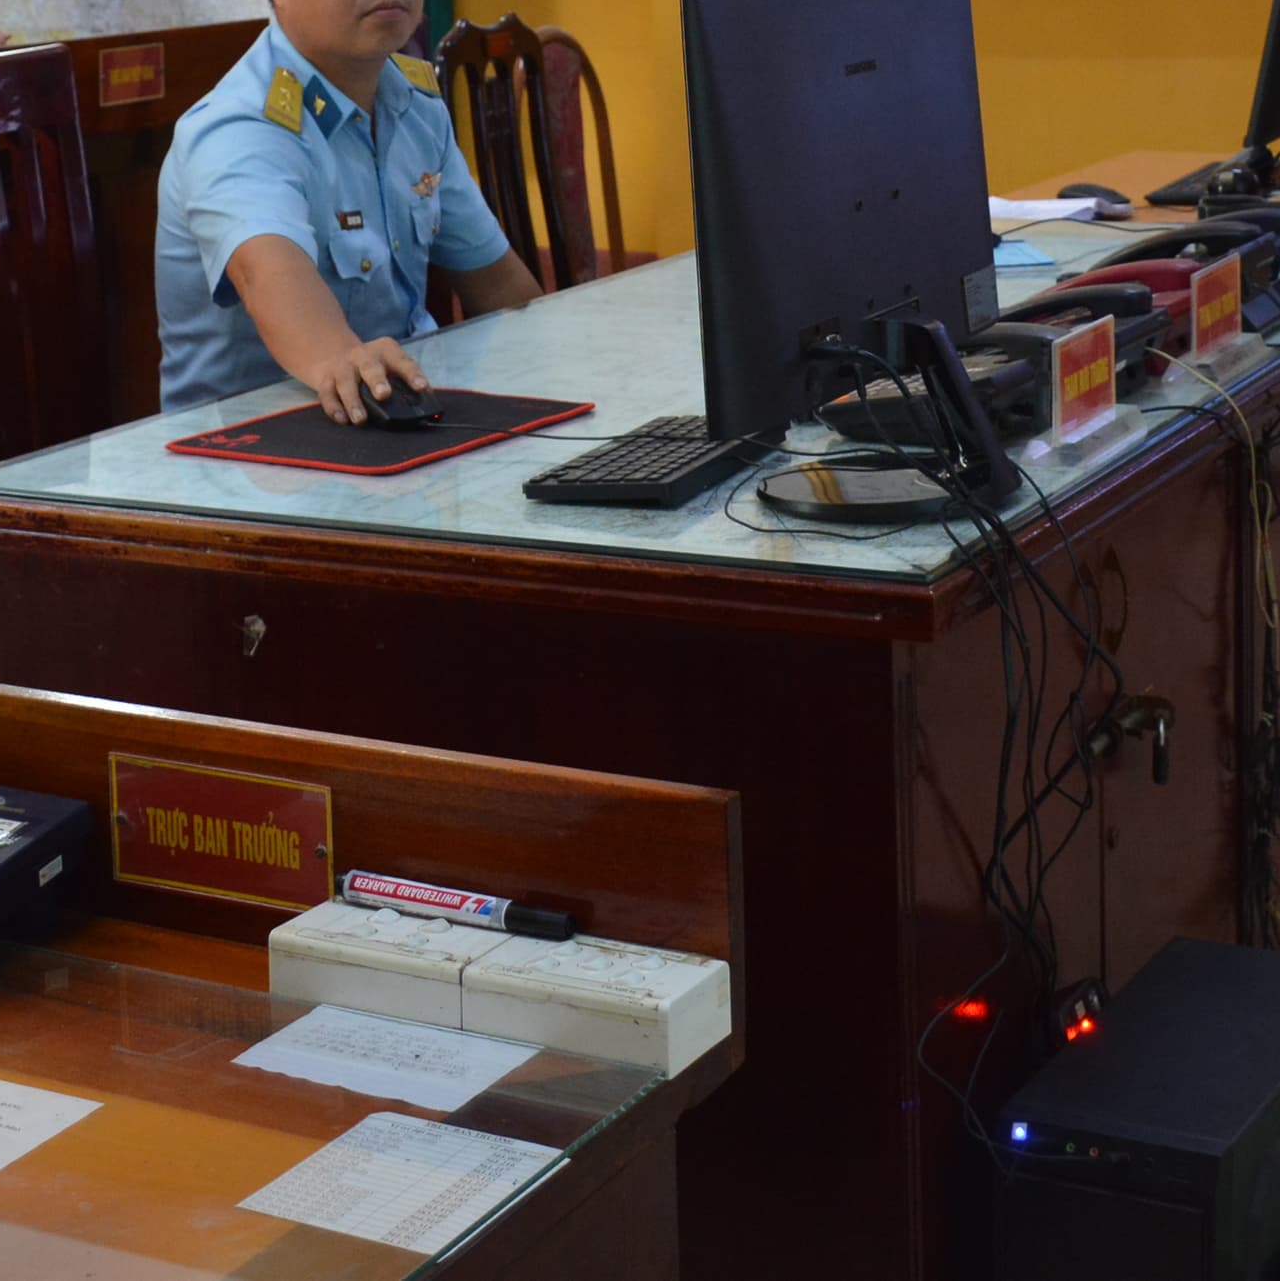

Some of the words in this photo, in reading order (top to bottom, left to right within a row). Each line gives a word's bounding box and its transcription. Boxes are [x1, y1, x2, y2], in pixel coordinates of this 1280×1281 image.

[146, 806, 189, 855] TRỰC
[193, 814, 229, 857] BAN
[232, 811, 300, 870] TRƯỞNG
[353, 876, 396, 896] MARKER
[396, 882, 463, 906] WHITEBOARD
